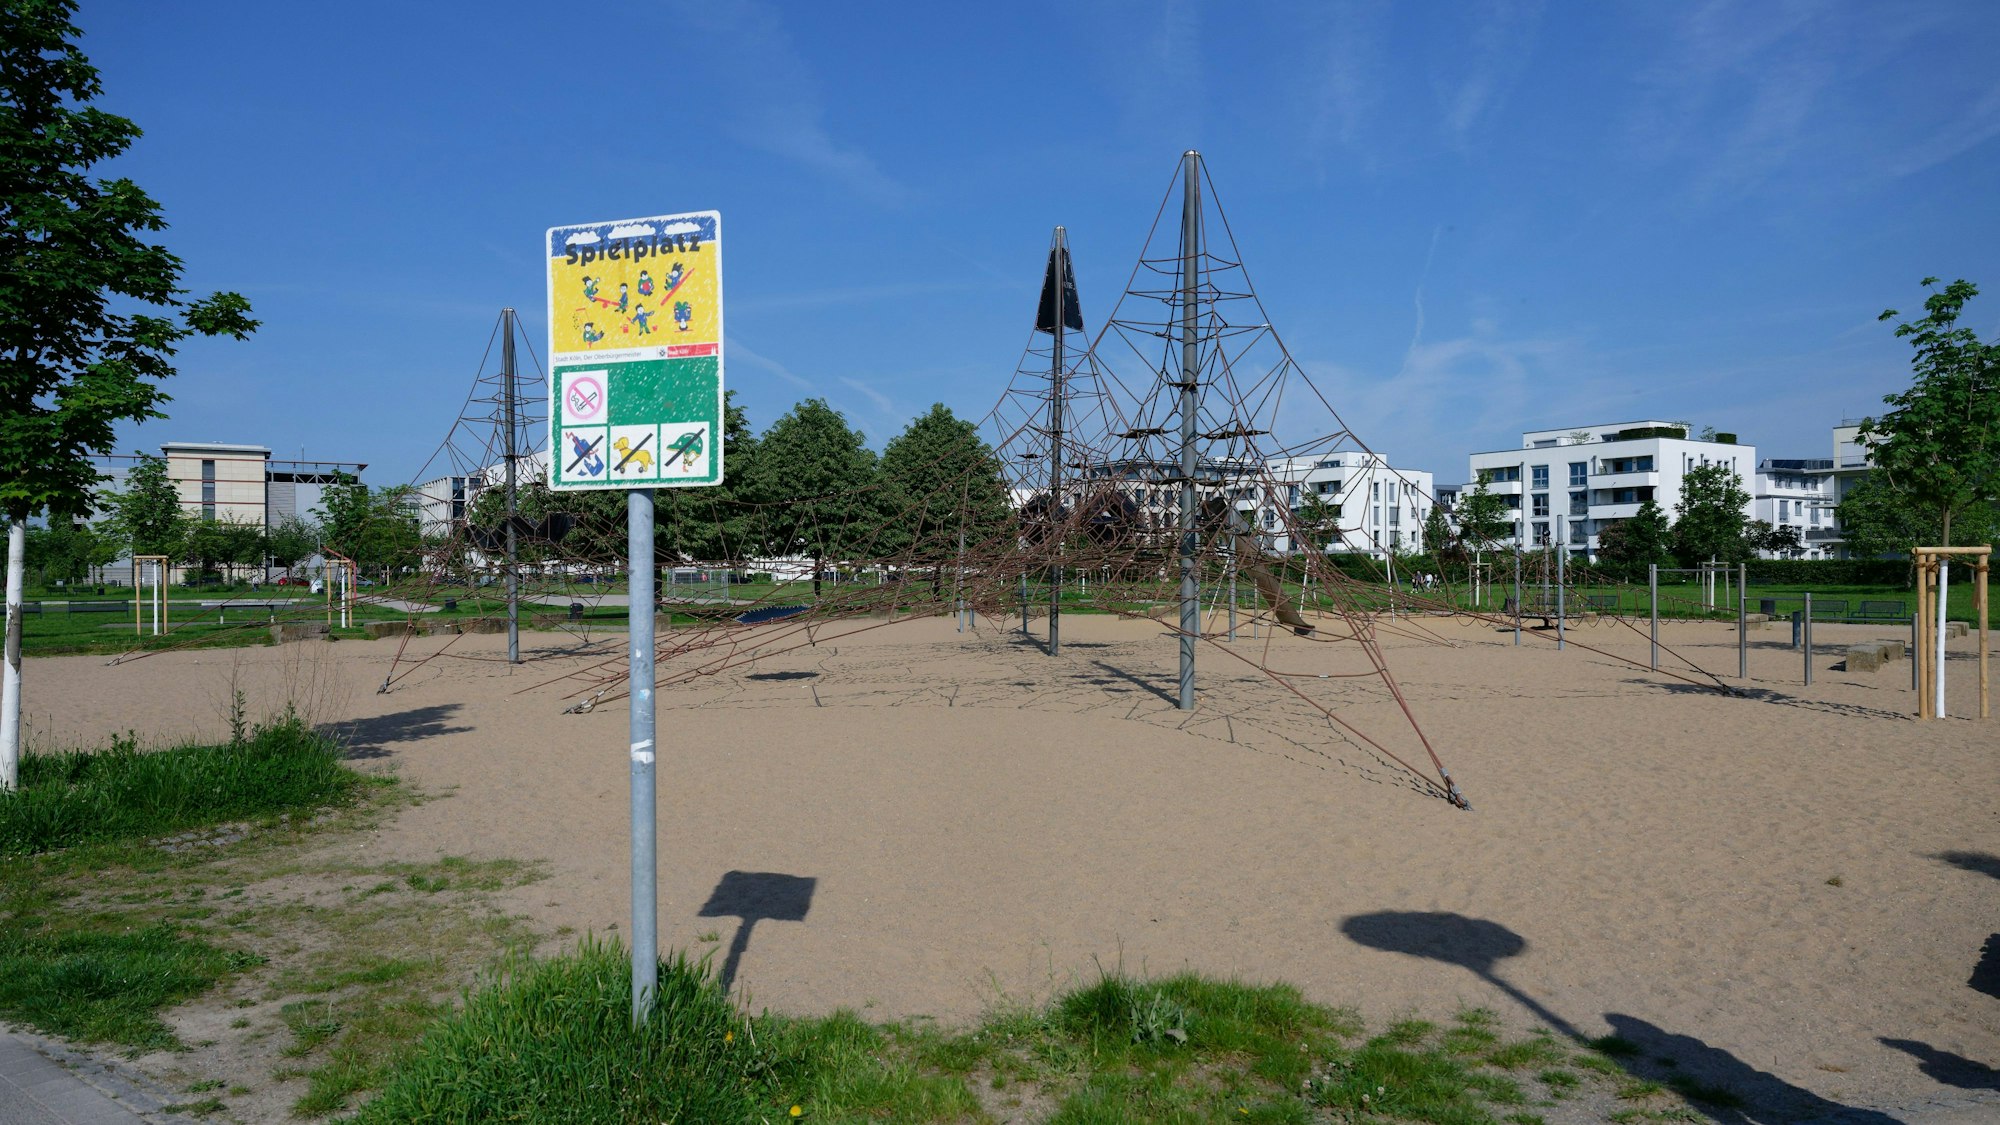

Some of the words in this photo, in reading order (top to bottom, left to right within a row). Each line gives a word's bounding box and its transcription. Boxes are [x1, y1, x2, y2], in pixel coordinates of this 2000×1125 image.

[565, 234, 701, 267] Spielplatz
[555, 355, 569, 363] Stadt
[594, 351, 642, 360] Oberbürgermeister
